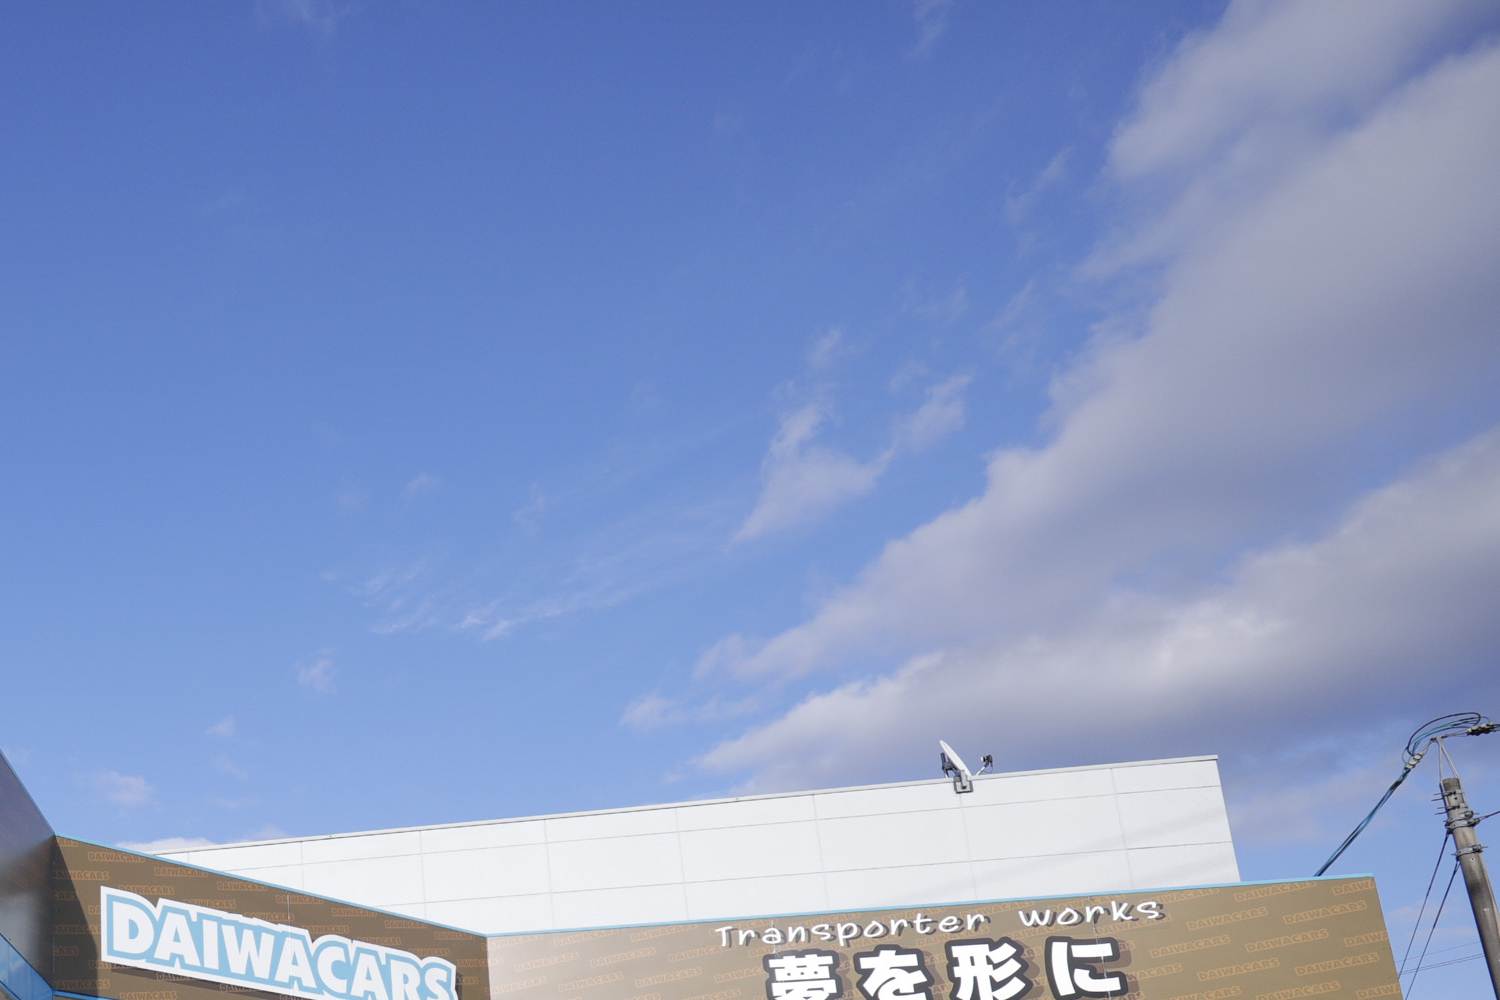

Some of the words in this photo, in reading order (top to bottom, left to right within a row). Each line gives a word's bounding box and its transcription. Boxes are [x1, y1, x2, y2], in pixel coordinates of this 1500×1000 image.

[88, 852, 145, 862] DAIWACARS
[1234, 881, 1316, 901] DAIWACARS
[715, 908, 986, 948] Transporter
[1018, 899, 1164, 927] works
[1187, 907, 1268, 930] DAIWACARS
[1283, 900, 1367, 924] DAIWACARS
[1149, 935, 1230, 958] DAIWACARS
[1245, 929, 1329, 952] DAIWACARS
[1197, 958, 1280, 981] DAIWACARS
[1294, 952, 1380, 976] DAIWACARS
[120, 991, 177, 1000] DAIWACARS
